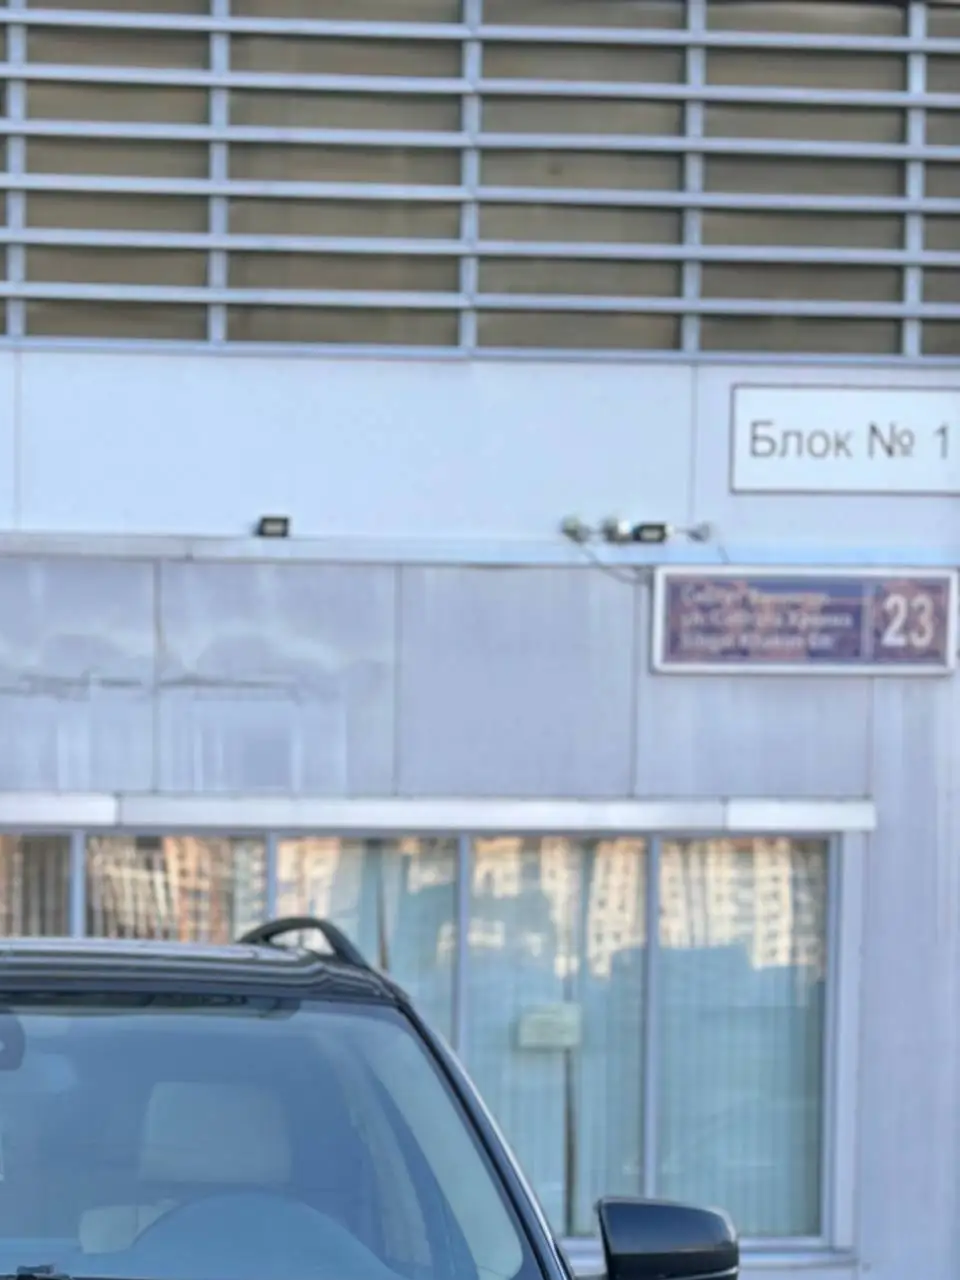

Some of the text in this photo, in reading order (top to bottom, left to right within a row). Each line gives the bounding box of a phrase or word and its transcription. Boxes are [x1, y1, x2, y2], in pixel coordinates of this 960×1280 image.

[748, 419, 950, 460] Блок № 1
[881, 593, 935, 649] 23
